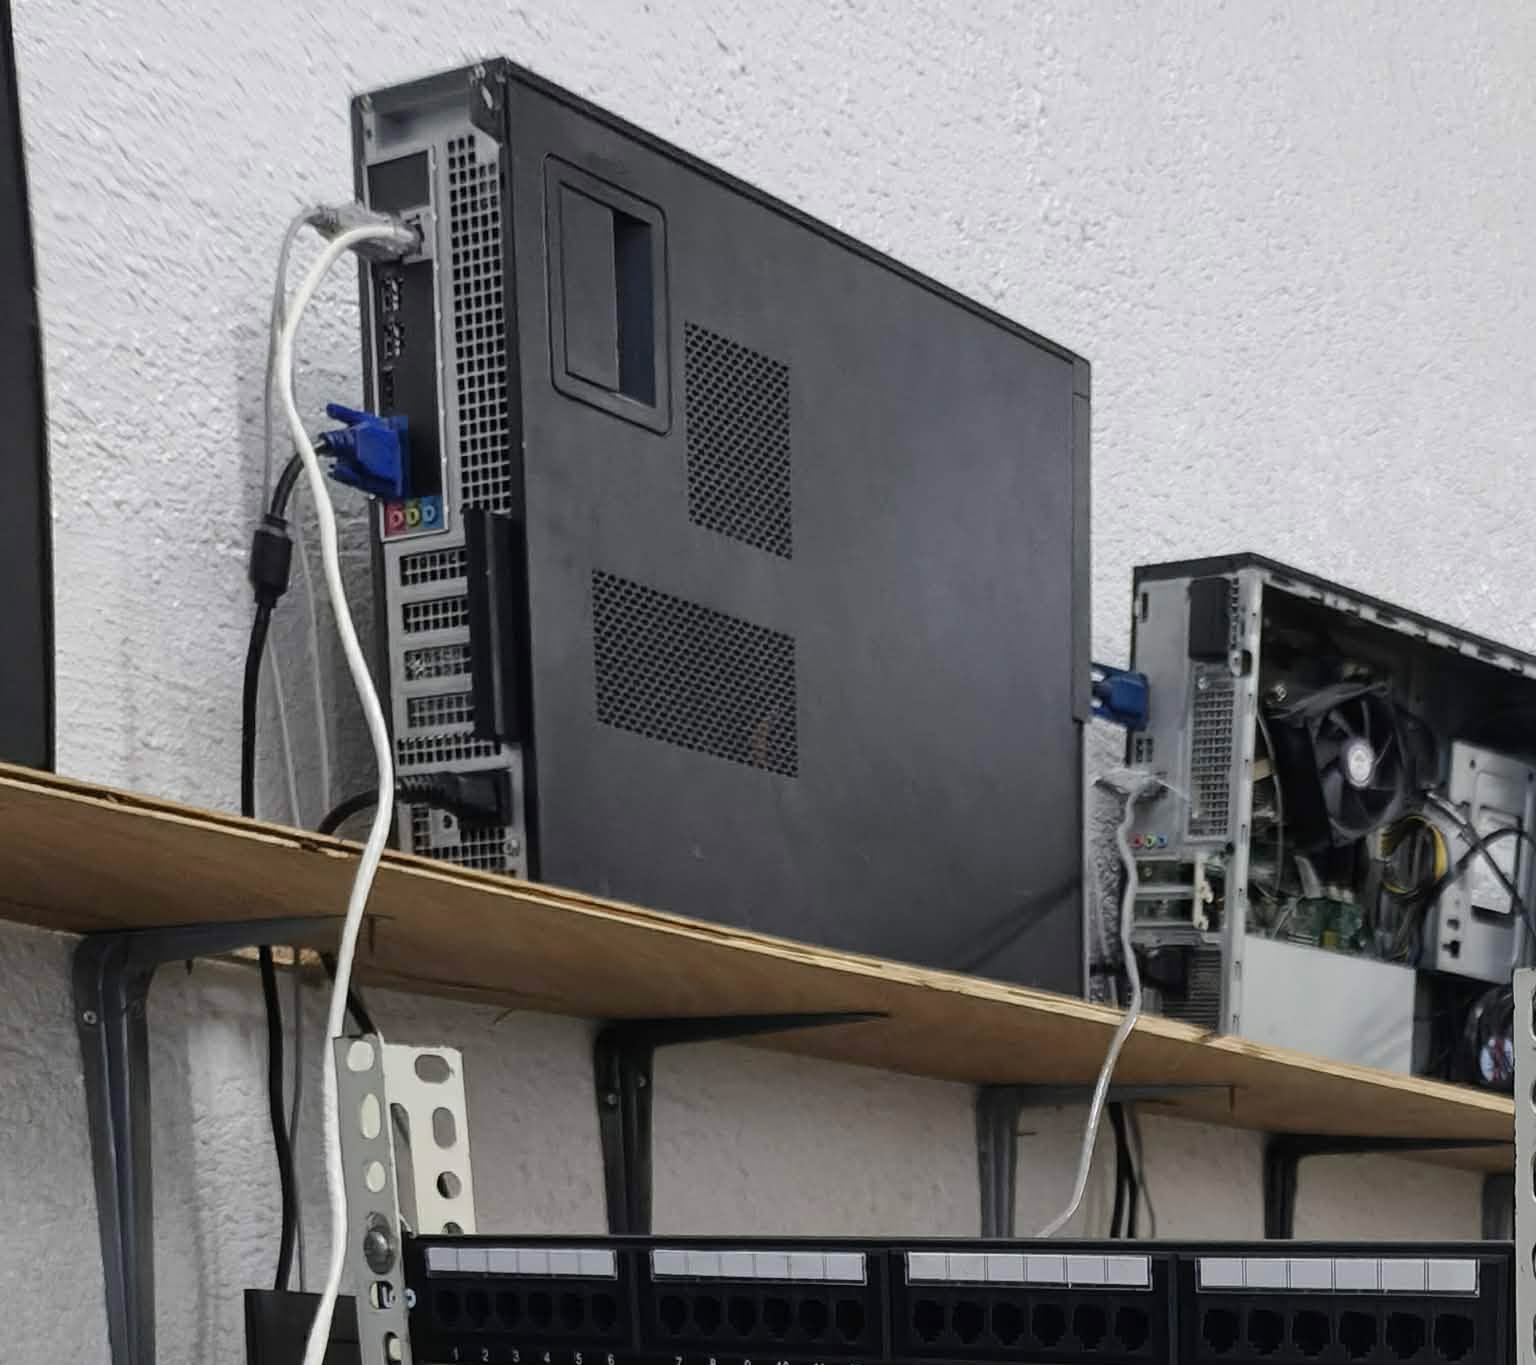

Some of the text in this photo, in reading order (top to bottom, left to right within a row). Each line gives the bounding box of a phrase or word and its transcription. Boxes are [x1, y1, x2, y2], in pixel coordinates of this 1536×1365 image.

[481, 1347, 489, 1362] 2
[512, 1349, 519, 1363] 3
[543, 1351, 551, 1364] 4
[575, 1352, 583, 1365] 5
